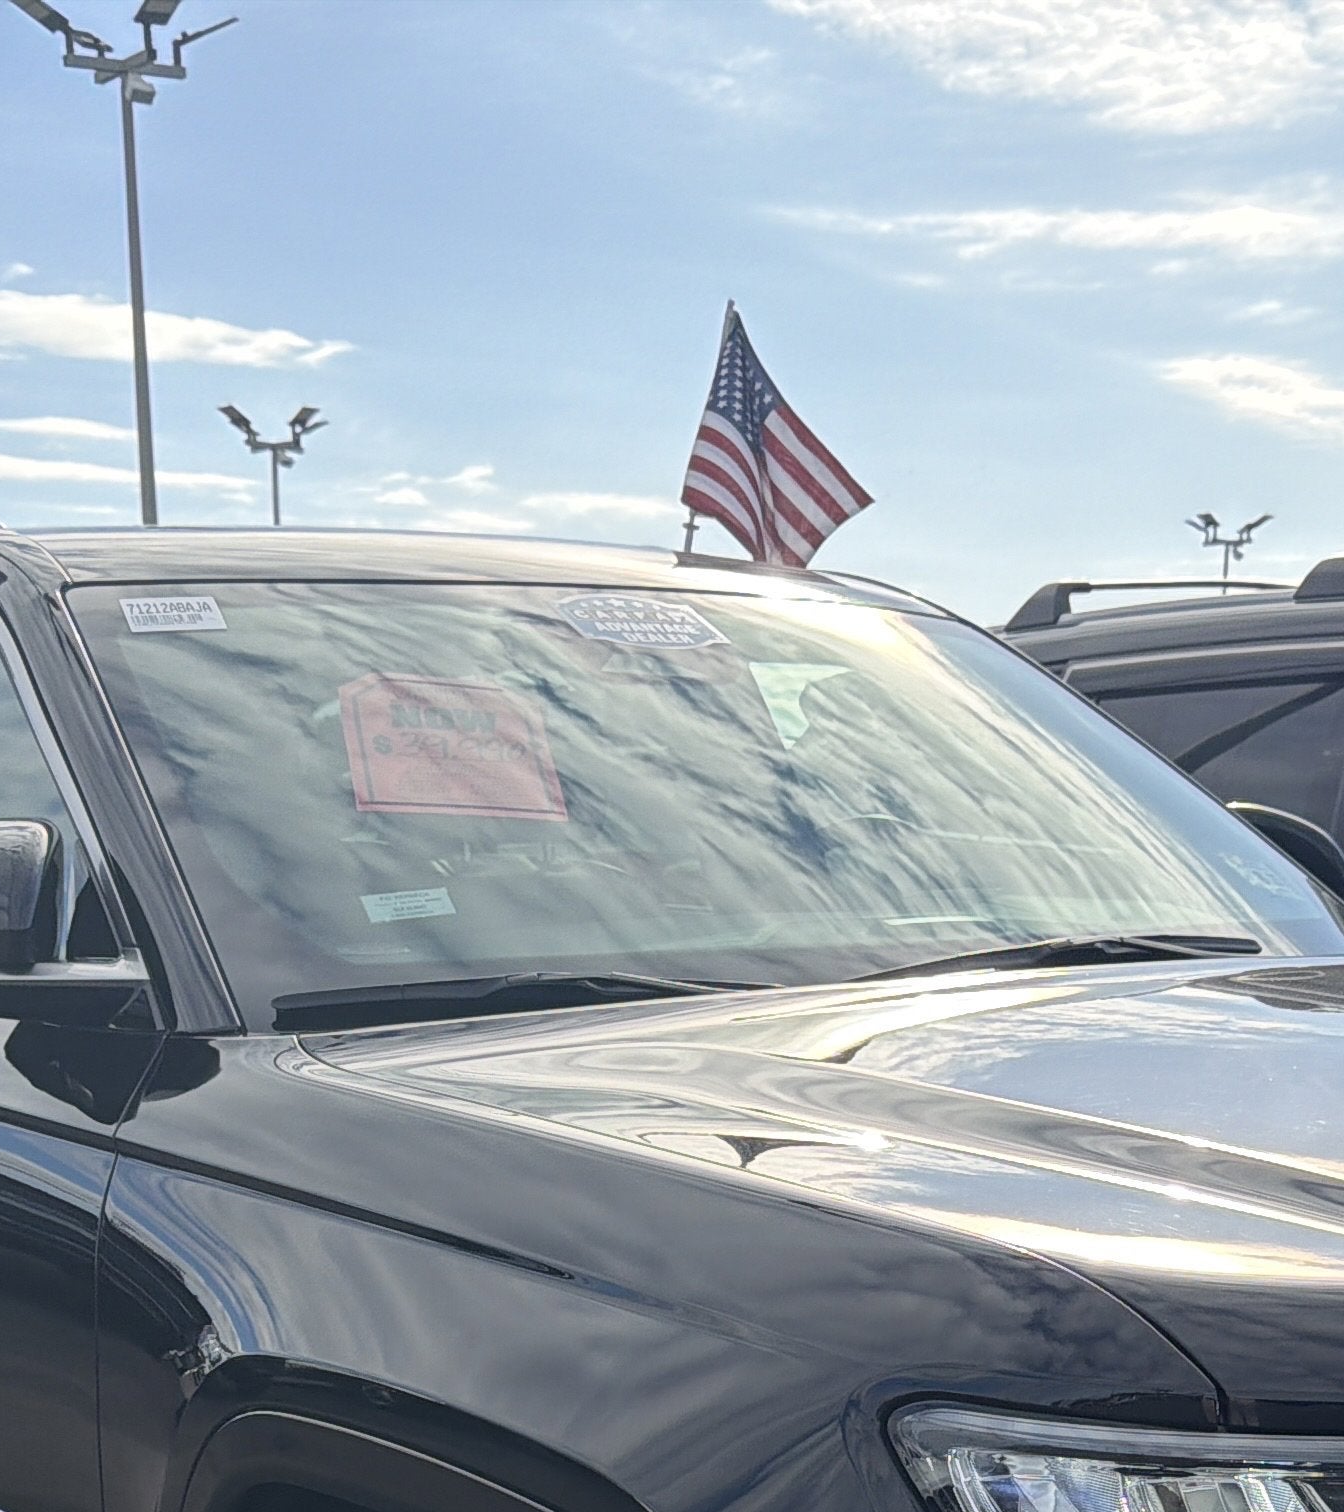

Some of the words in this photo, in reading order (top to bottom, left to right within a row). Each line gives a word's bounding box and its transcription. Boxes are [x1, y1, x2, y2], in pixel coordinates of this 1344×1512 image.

[594, 621, 701, 635] ADVANTAGE
[622, 632, 696, 645] DEALER
[389, 702, 497, 734] NOW
